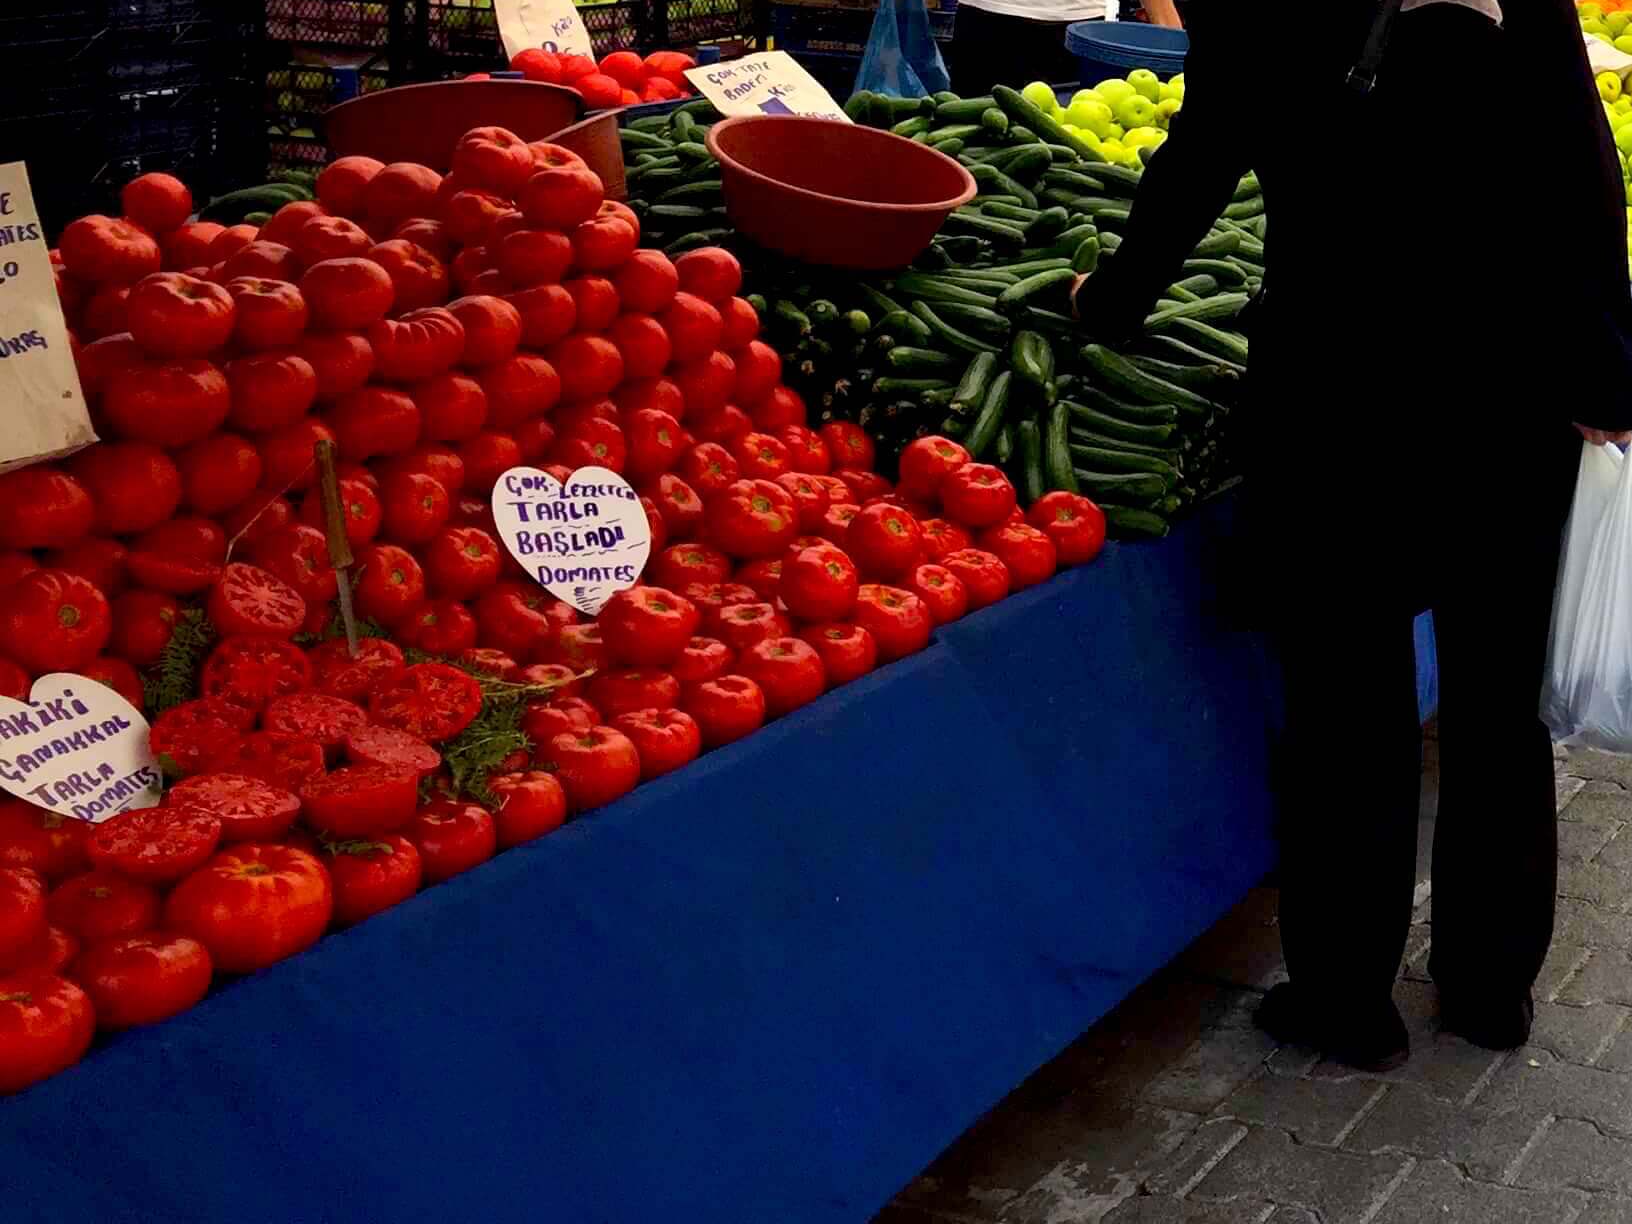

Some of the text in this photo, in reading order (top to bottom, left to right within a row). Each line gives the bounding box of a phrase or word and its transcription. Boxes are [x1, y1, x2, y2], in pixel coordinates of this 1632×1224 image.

[506, 500, 599, 523] TARLA
[537, 564, 635, 585] DOMATES
[27, 762, 115, 807] TARLA
[71, 766, 158, 822] DOMATES
